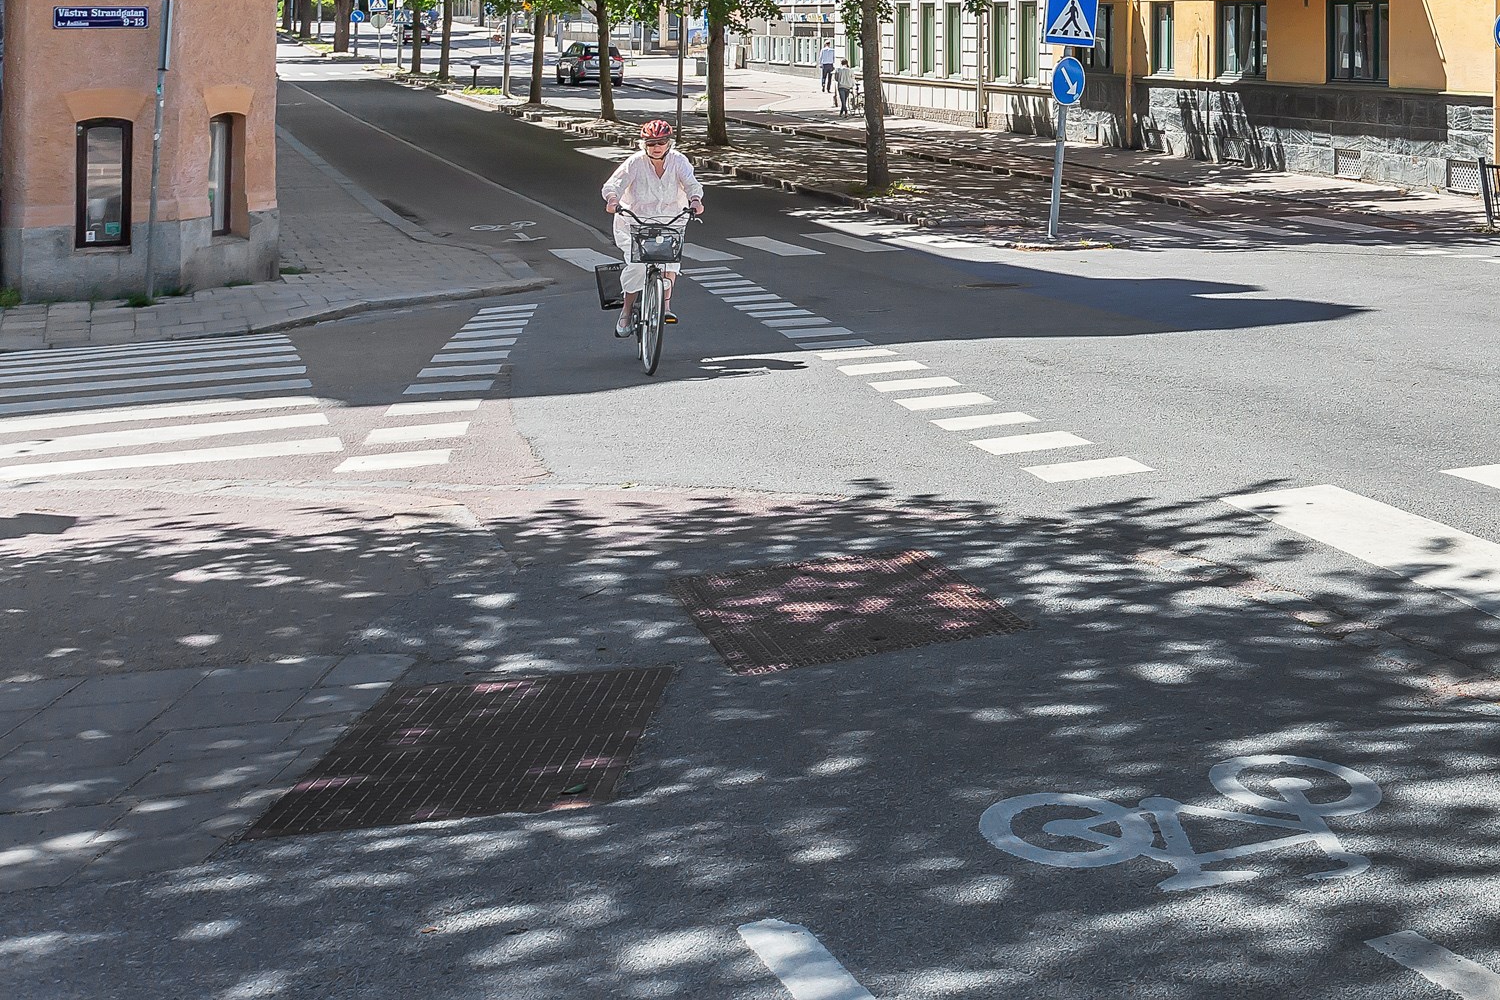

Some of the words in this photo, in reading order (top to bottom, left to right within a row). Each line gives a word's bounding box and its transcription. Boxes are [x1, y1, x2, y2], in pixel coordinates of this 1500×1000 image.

[58, 9, 88, 17] Västra
[91, 9, 144, 19] Strandgatan
[123, 18, 144, 26] 9-13
